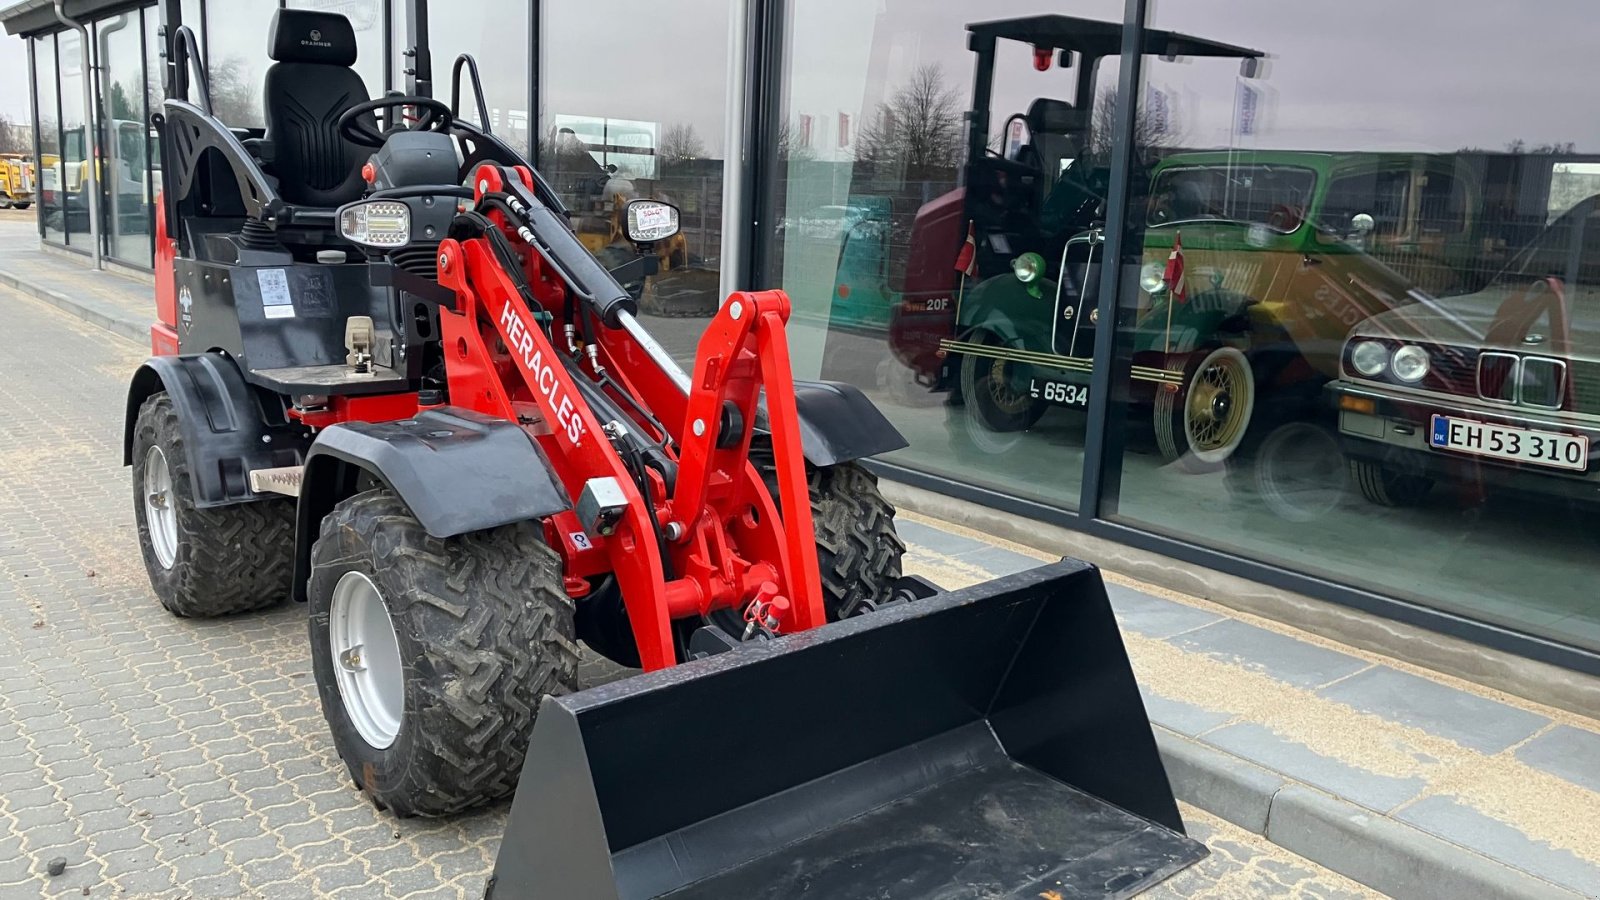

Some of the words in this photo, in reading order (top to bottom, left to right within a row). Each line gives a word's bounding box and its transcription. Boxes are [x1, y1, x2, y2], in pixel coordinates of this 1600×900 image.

[500, 300, 583, 444] HERACLES
[1044, 381, 1088, 406] 6534
[1434, 433, 1444, 441] DK
[1450, 423, 1483, 449] EH
[1489, 430, 1521, 455] 53
[1528, 435, 1581, 464] 310
